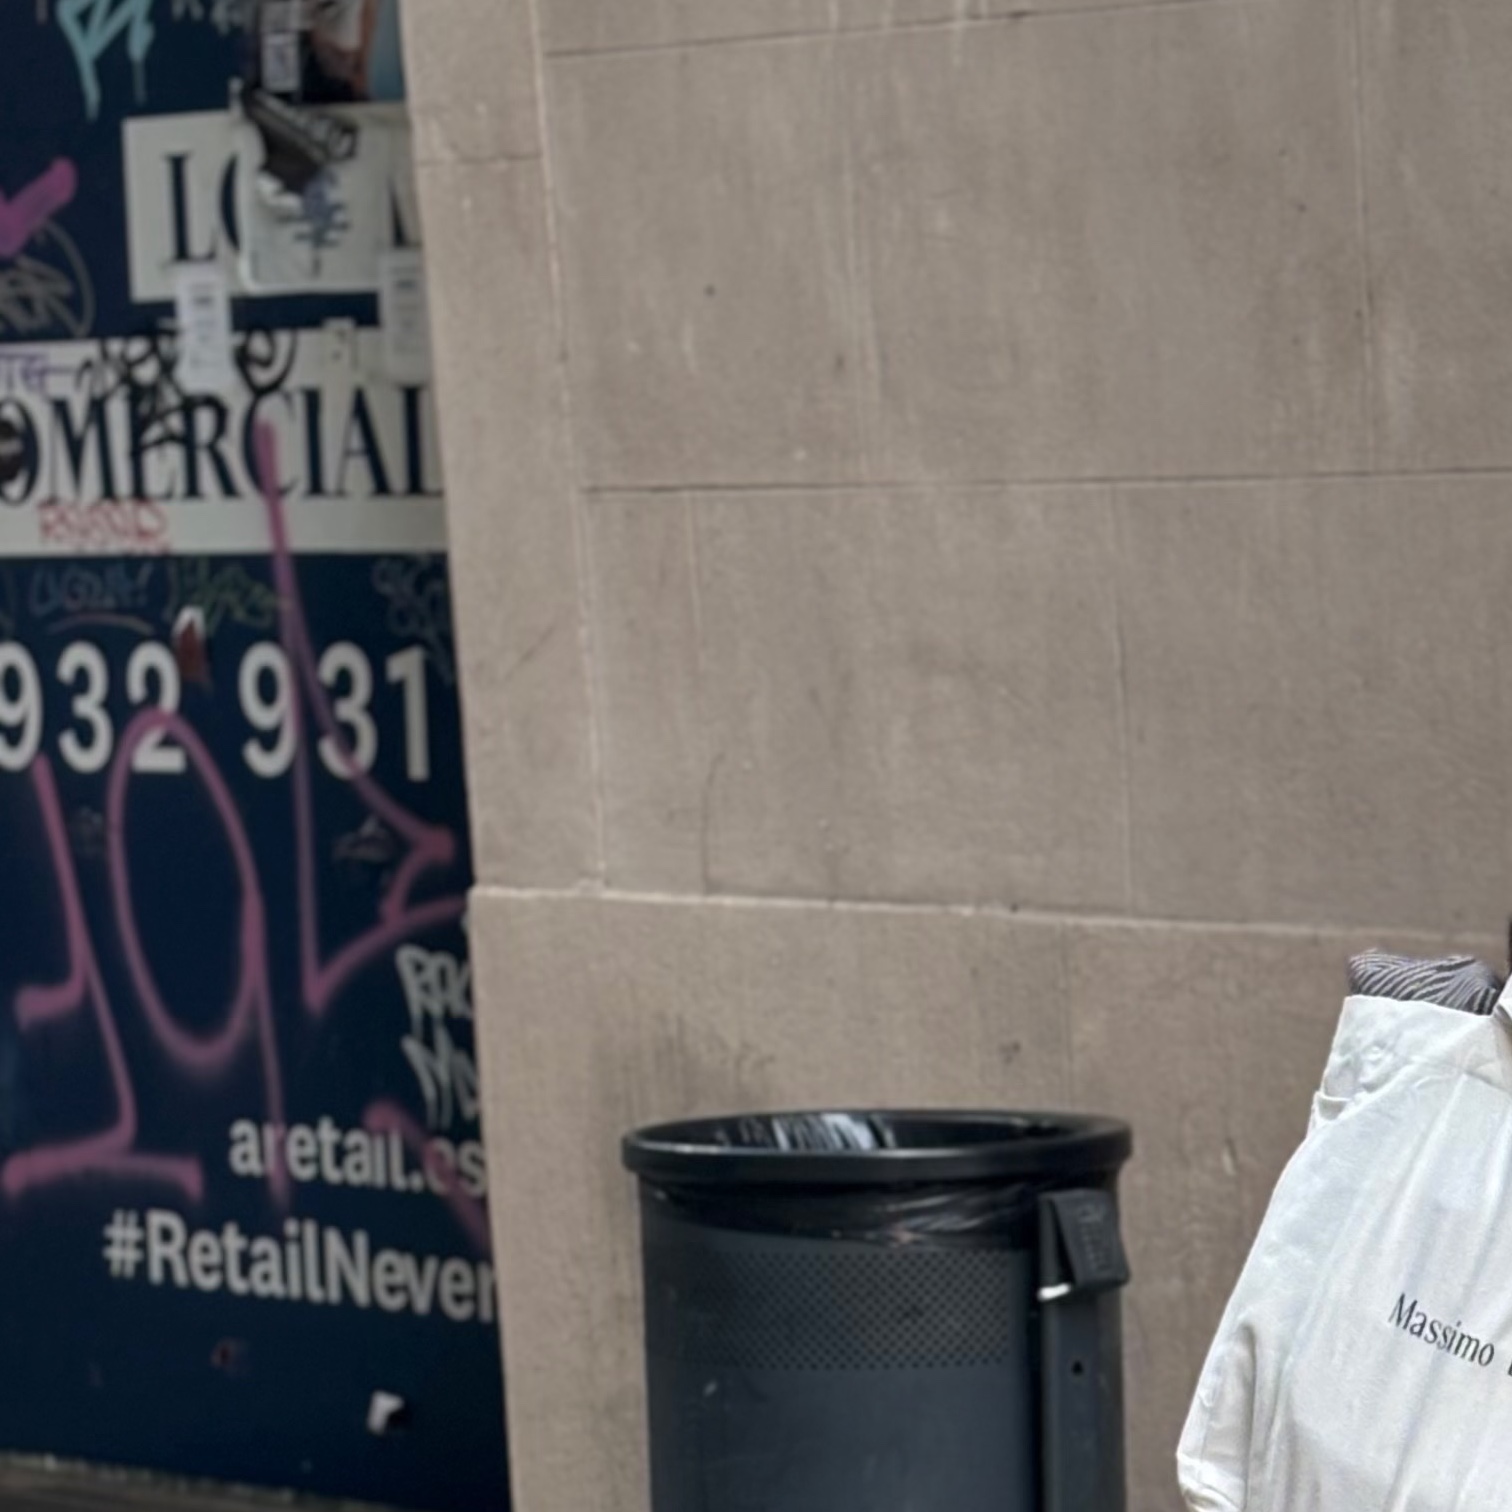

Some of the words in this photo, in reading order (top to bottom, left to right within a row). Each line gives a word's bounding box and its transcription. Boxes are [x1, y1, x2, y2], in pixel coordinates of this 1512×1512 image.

[0, 641, 188, 773] 932
[238, 641, 431, 782] 931
[103, 1208, 497, 1324] #RetailNever
[1387, 1293, 1495, 1367] Massimo
